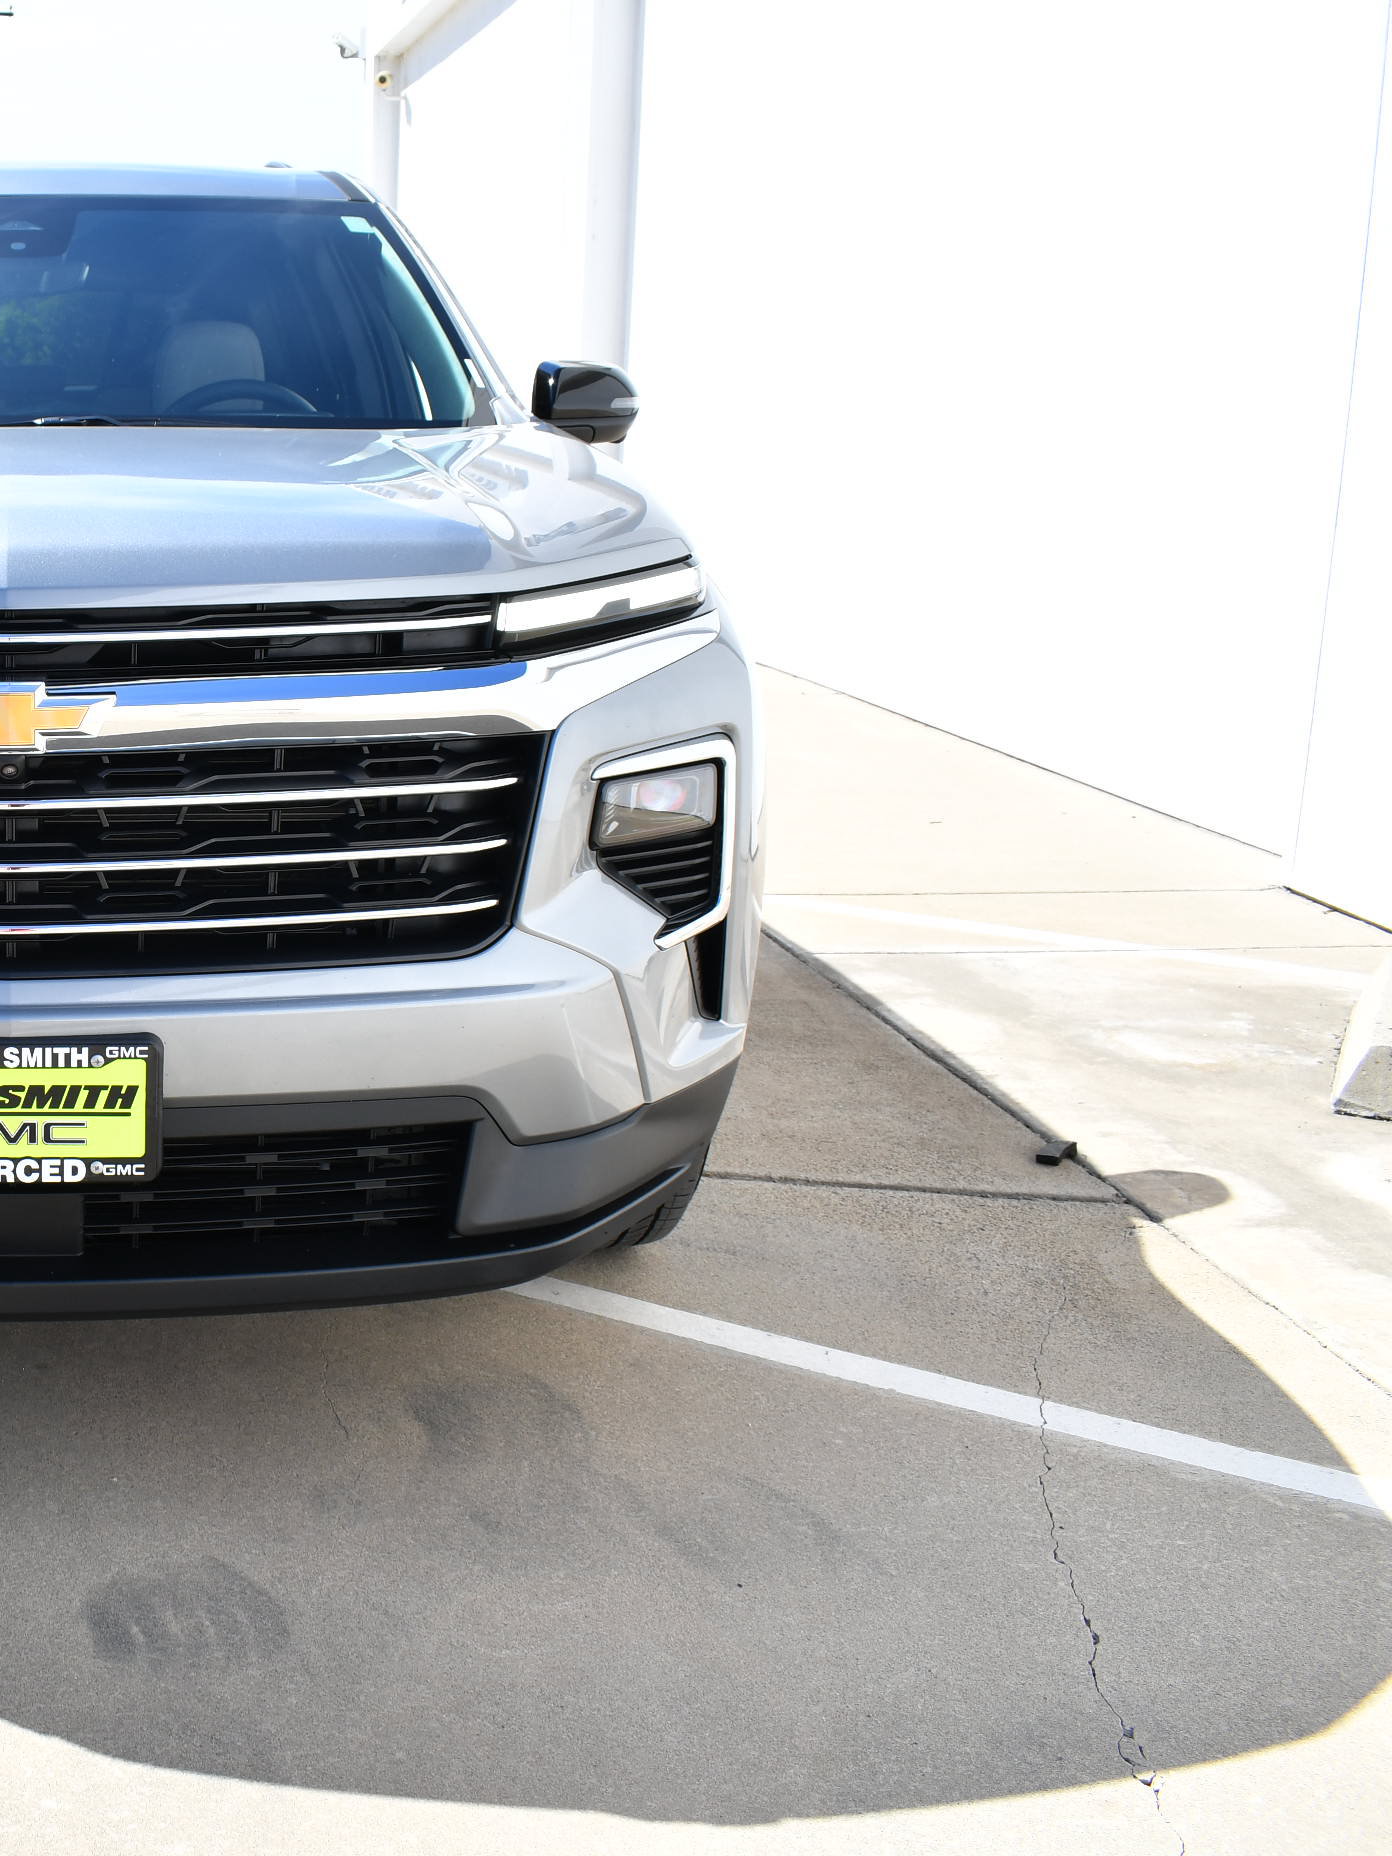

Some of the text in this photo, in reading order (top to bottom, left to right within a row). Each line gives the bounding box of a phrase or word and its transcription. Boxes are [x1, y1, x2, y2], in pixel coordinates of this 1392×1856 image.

[3, 1047, 89, 1068] SMITH
[105, 1046, 149, 1058] GMC
[102, 1164, 145, 1176] GMC
